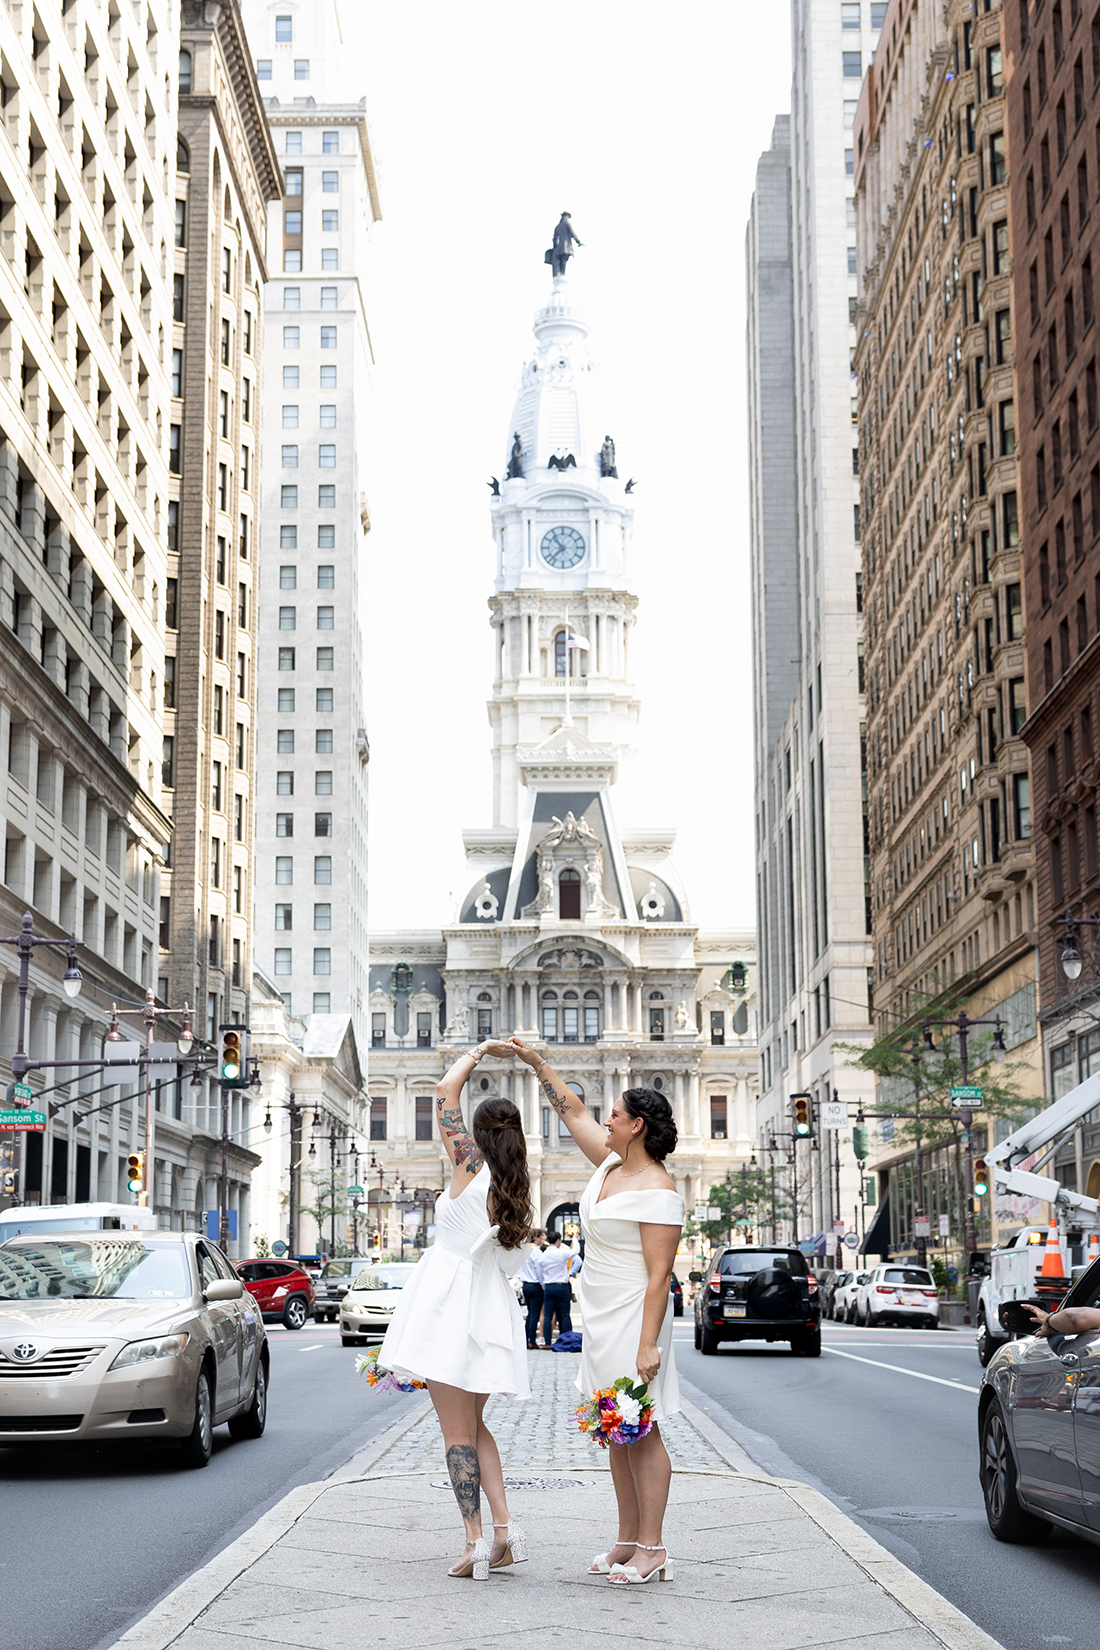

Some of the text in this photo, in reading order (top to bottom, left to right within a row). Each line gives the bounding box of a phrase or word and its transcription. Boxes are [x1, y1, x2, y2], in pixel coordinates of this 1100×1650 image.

[828, 1105, 841, 1115] NO
[34, 1114, 43, 1122] St
[823, 1117, 847, 1125] TURNS
